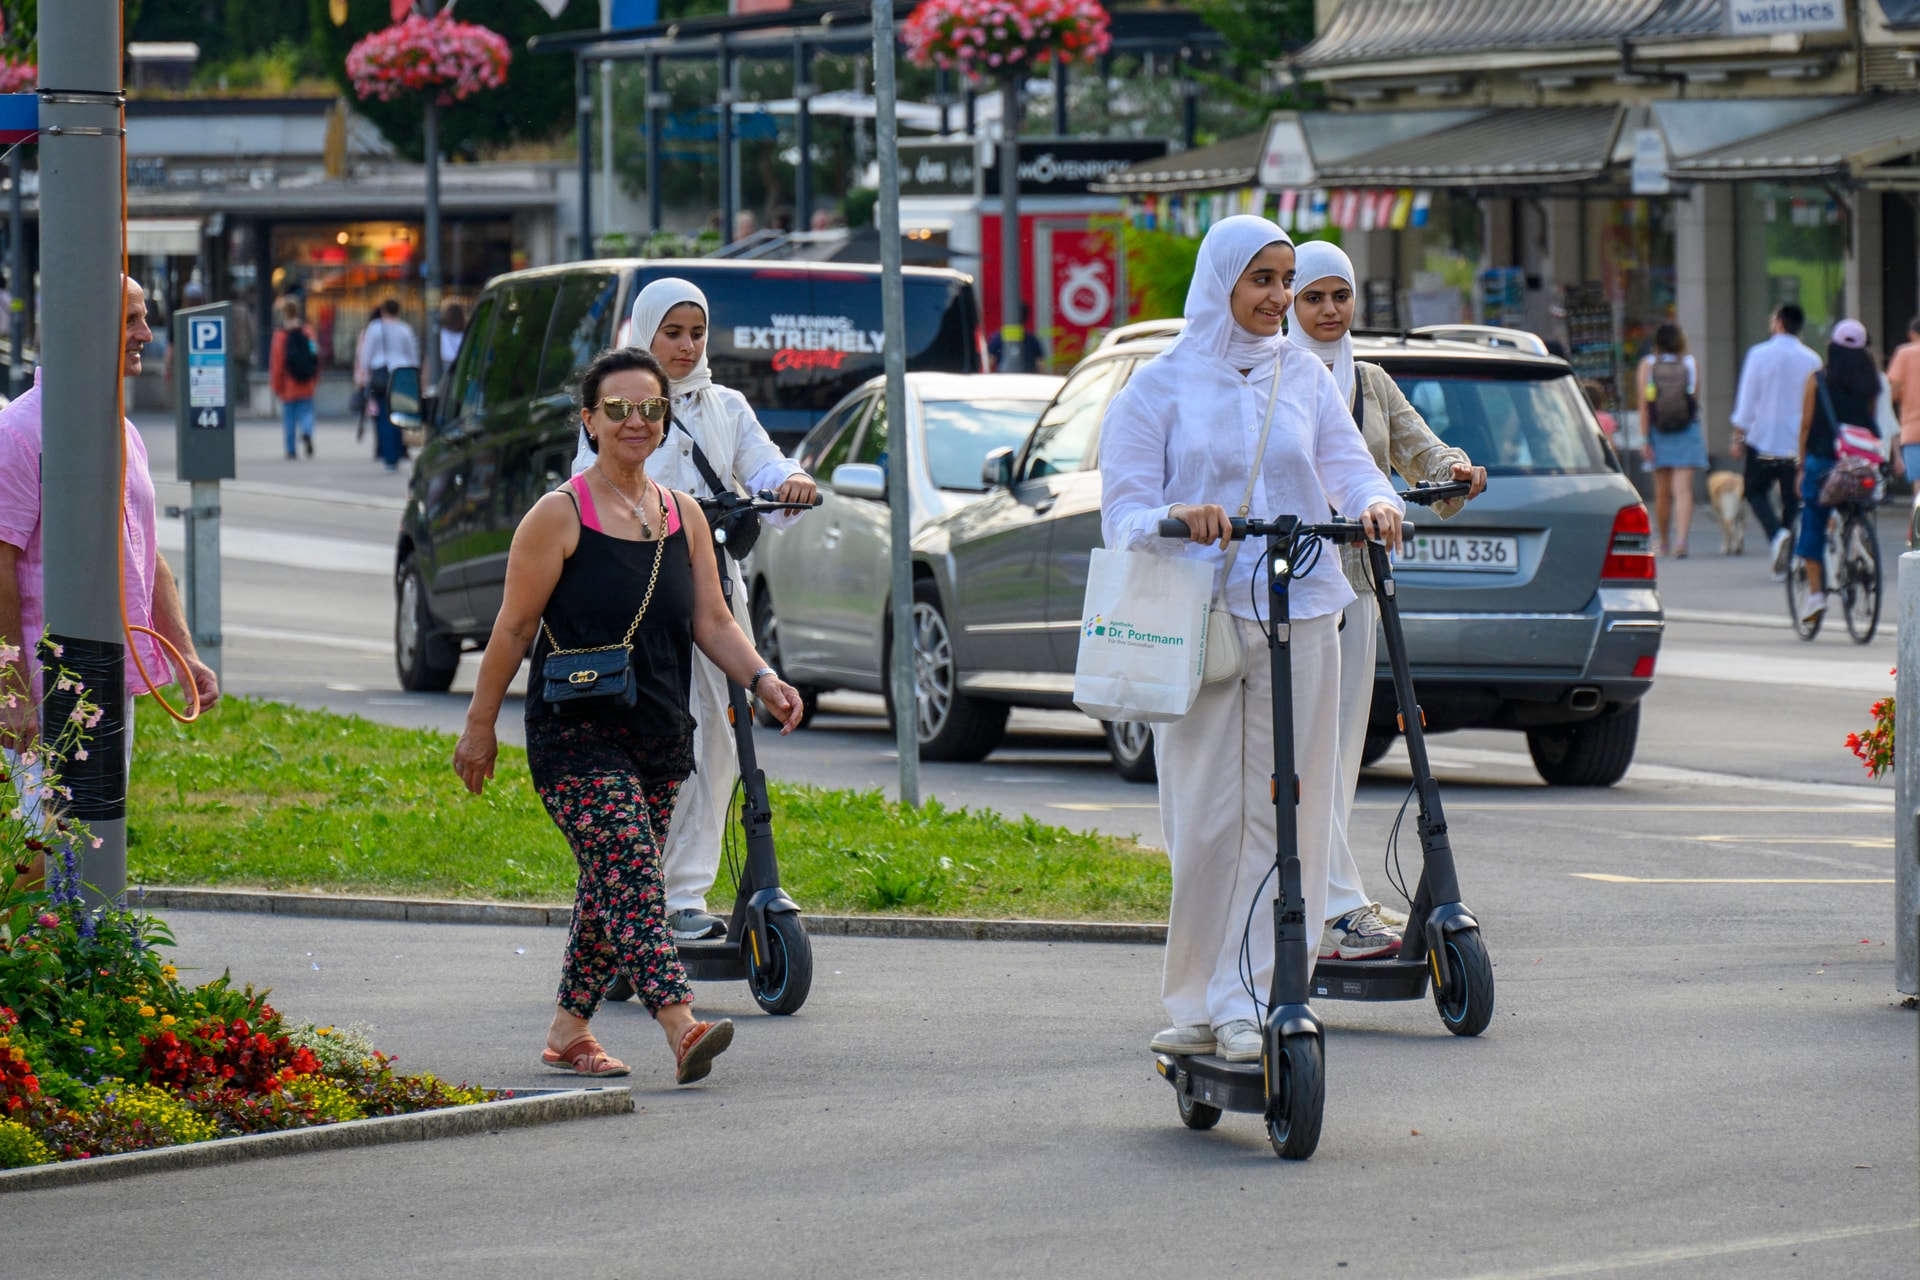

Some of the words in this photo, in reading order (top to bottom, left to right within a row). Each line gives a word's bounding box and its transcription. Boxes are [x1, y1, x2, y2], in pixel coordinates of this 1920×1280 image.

[1737, 2, 1835, 24] watches
[196, 322, 218, 350] P
[733, 325, 886, 354] EXTREMELY
[197, 410, 219, 428] 44
[1431, 539, 1460, 561] UA
[1466, 540, 1507, 562] 336
[1109, 620, 1134, 628] Apotheke
[1108, 627, 1124, 639] Dr.
[1128, 629, 1184, 646] Portmann
